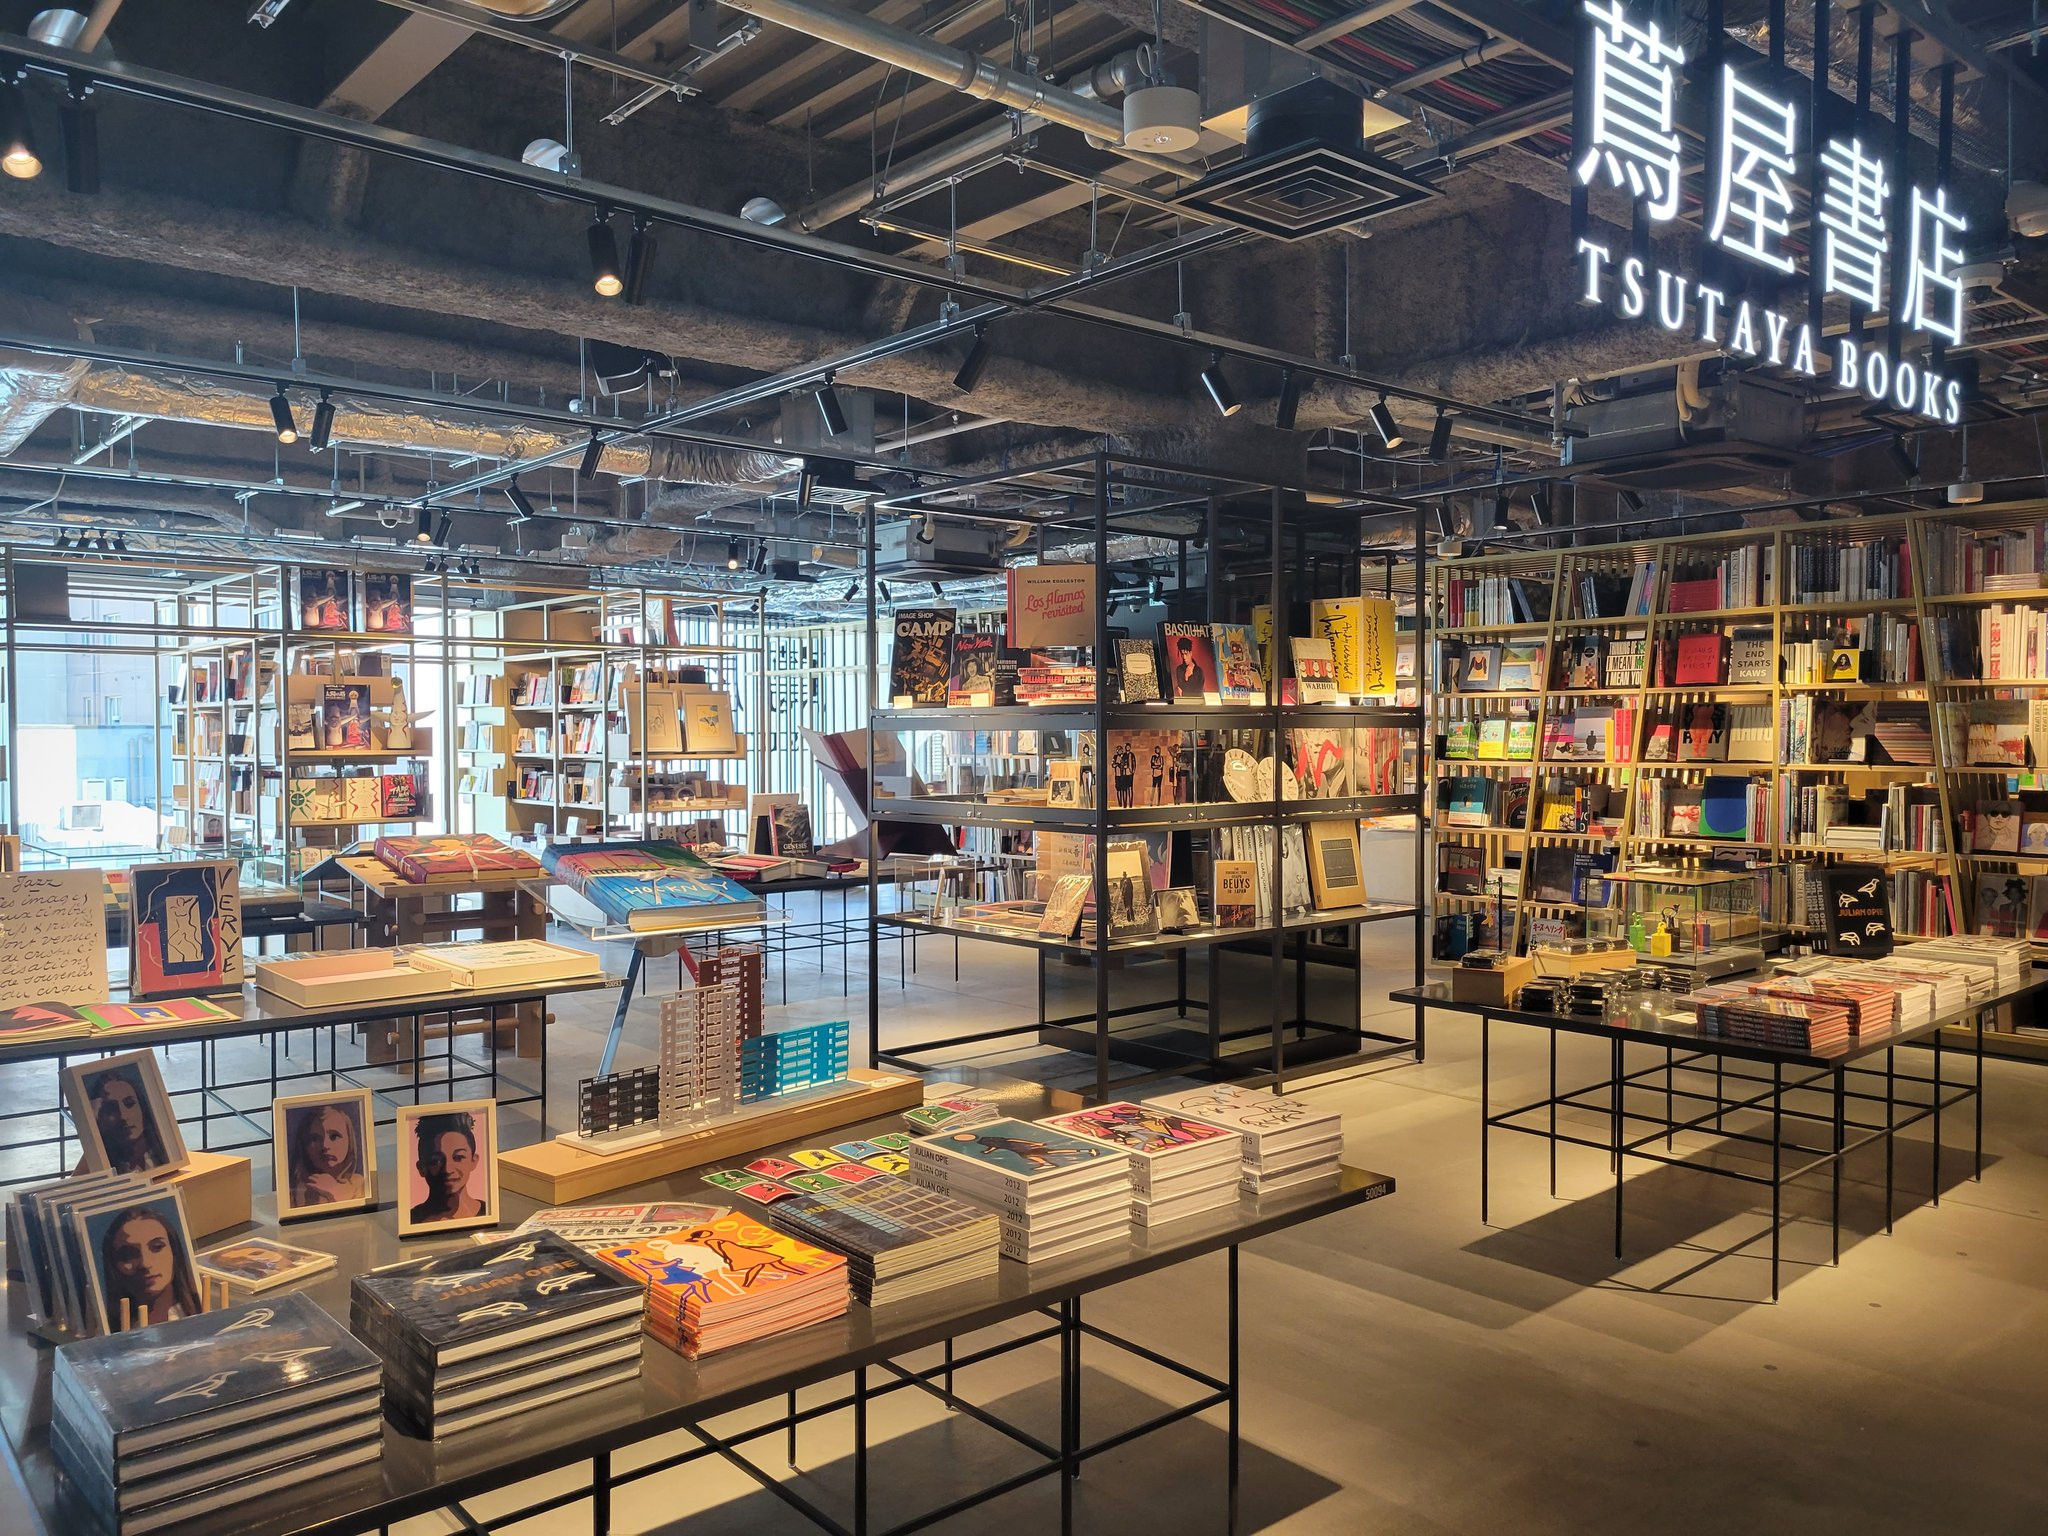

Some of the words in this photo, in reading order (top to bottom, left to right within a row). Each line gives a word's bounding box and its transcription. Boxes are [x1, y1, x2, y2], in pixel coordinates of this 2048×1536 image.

[1577, 0, 1968, 346] 蔦屋書店
[1577, 238, 1817, 376] TSUTAYA
[1838, 338, 1961, 425] BOOKS
[1024, 594, 1044, 612] Los
[1044, 588, 1086, 610] Alamos
[917, 611, 934, 619] SHOP
[1041, 603, 1085, 621] revisited
[896, 620, 954, 638] CAMP
[1163, 622, 1211, 638] BASQUIAT
[956, 639, 976, 651] New
[974, 636, 993, 649] York
[1746, 640, 1765, 648] THE
[1744, 650, 1765, 658] END
[1737, 659, 1772, 668] STARTS
[1739, 669, 1767, 678] KAWS
[1305, 682, 1336, 691] WARHOL
[783, 842, 808, 850] GENESIS
[12, 875, 63, 893] Jazz
[1222, 877, 1250, 890] BEUYS
[1838, 908, 1866, 916] JULIAN
[1866, 908, 1884, 916] OPIE
[218, 867, 240, 974] VERVE
[914, 1147, 935, 1160] JULIAN
[935, 1154, 949, 1166] OPIE
[913, 1160, 934, 1174] JULIAN
[934, 1167, 948, 1181] OPIE
[914, 1177, 936, 1192] JULIAN
[936, 1184, 950, 1197] OPIE
[1004, 1177, 1021, 1191] 2012
[1003, 1193, 1020, 1207] 2012
[1006, 1210, 1023, 1224] 2012
[1005, 1227, 1022, 1241] 2012
[1004, 1243, 1021, 1257] 2012
[437, 1272, 524, 1302] JULIAN
[524, 1258, 580, 1279] OPIE
